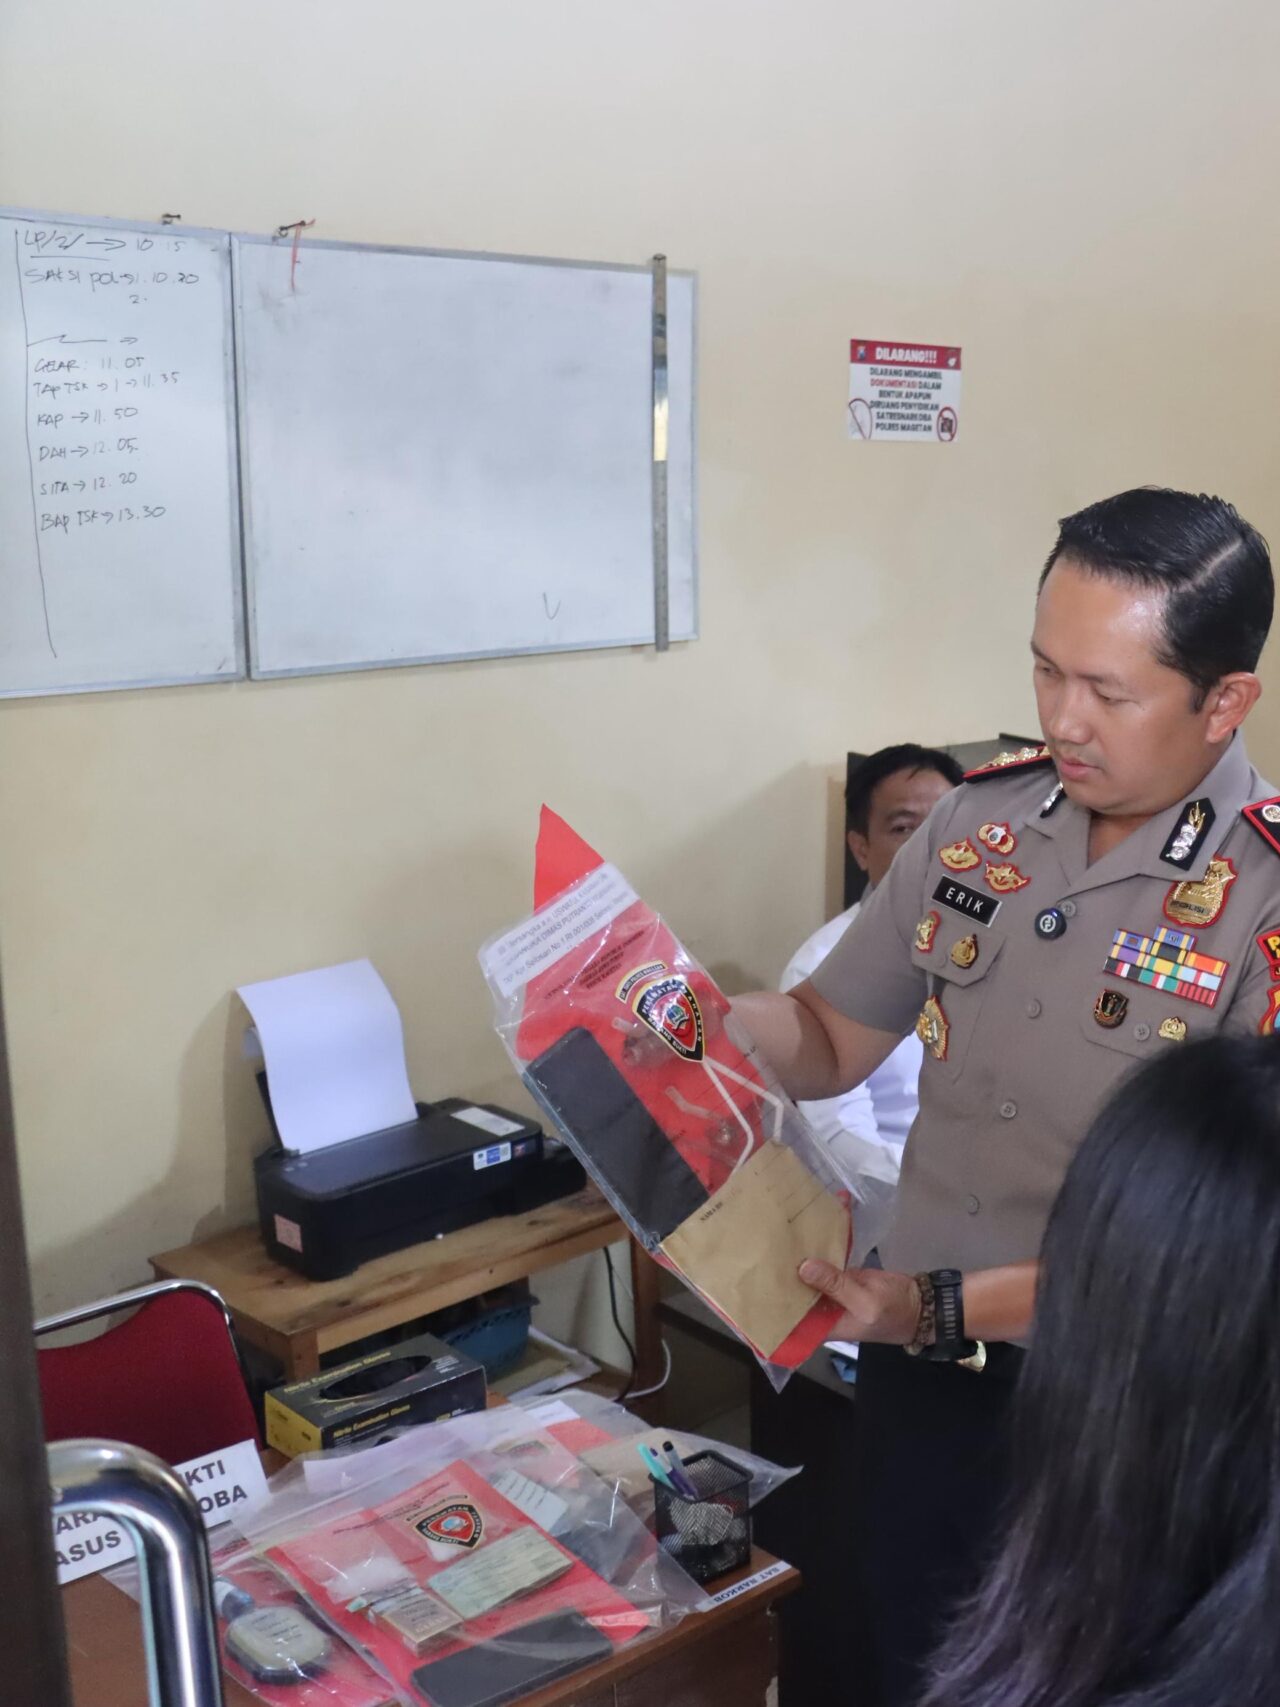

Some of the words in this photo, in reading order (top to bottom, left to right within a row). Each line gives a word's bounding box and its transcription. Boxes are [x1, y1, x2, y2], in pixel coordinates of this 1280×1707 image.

[875, 347, 937, 364] DILARANG!!!
[869, 367, 903, 377] DILARANG
[904, 369, 942, 380] MENGAMBIL
[870, 378, 918, 389] DOKUMENTASI
[918, 381, 942, 390] DALAM
[878, 389, 903, 399] BENTUK
[904, 391, 932, 400] APAPUN
[900, 401, 939, 411] PENYIDIKAN
[875, 422, 900, 431] POLRES
[900, 423, 932, 432] MAGETAN
[945, 887, 983, 913] ERIK
[183, 1459, 226, 1487] KTI
[55, 1530, 121, 1568] ASUS
